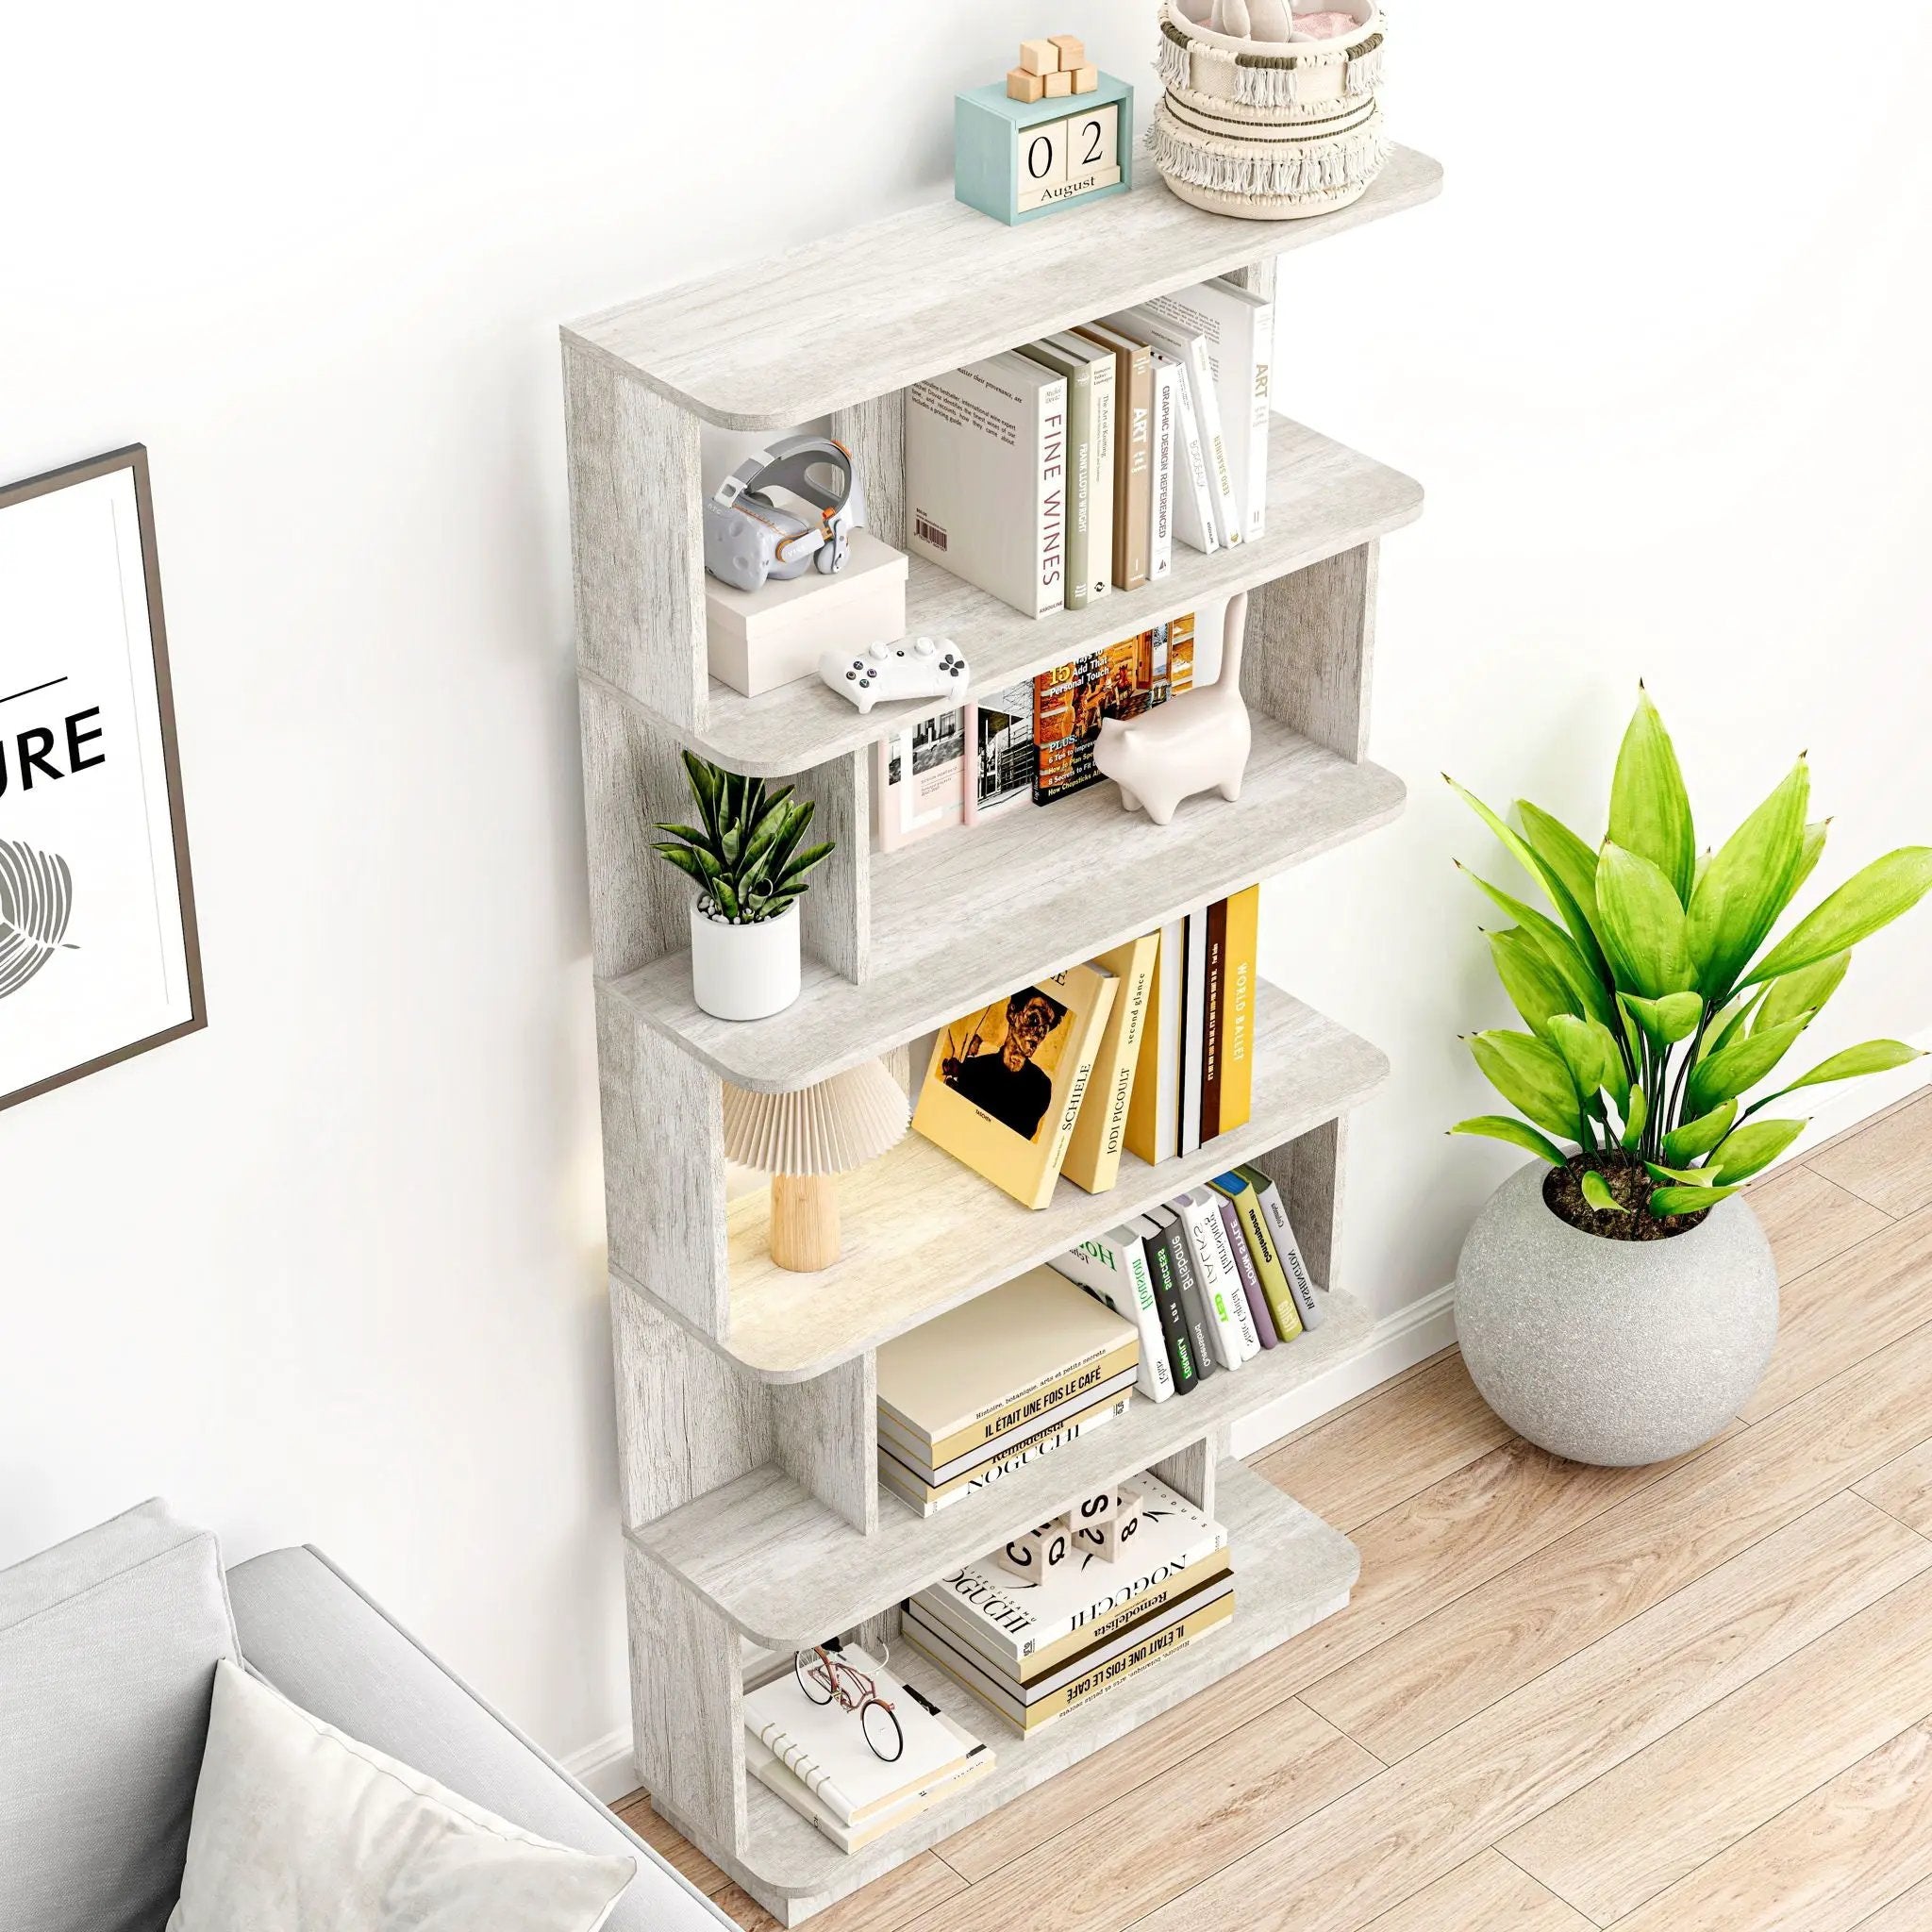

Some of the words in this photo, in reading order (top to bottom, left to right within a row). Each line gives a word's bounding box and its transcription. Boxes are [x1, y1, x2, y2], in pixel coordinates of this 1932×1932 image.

[1041, 176, 1095, 201] August
[1255, 364, 1269, 397] ART
[1103, 421, 1108, 429] of
[1133, 408, 1148, 443] ART
[1044, 414, 1061, 481] FINE
[1079, 442, 1089, 469] FRANK
[1161, 433, 1170, 471] DESIGN
[1078, 470, 1088, 499] LLOYD
[1078, 500, 1088, 533] WRIGHT
[1159, 473, 1168, 539] REFERENCED
[1042, 490, 1060, 586] WINES
[1050, 665, 1071, 686] 15
[1073, 665, 1088, 676] Add
[1091, 657, 1108, 670] That
[1050, 675, 1084, 697] Personal
[1087, 667, 1109, 682] Touch
[0, 706, 106, 798] RE
[1049, 735, 1077, 753] PLUS:
[1055, 752, 1066, 761] Tips
[1048, 765, 1060, 774] How
[1070, 758, 1082, 767] Plan
[1082, 752, 1094, 760] Spe
[1054, 771, 1075, 783] Secrets
[1048, 788, 1060, 796] How
[1061, 774, 1091, 790] Chopsticks
[1235, 962, 1248, 1011] WORLD
[1127, 1009, 1139, 1044] second
[1134, 973, 1145, 1006] glance
[1233, 1015, 1245, 1061] BALLET
[1062, 1063, 1091, 1131] SCHIELE
[1112, 1068, 1130, 1124] PICOULT
[974, 1108, 991, 1123] TASCHEN
[1107, 1124, 1121, 1155] JODI
[1040, 1374, 1054, 1387] arts
[1055, 1371, 1061, 1379] et
[1062, 1361, 1081, 1375] petits
[1082, 1349, 1107, 1364] secrets
[985, 1424, 994, 1438] IL
[995, 1408, 1022, 1433] ÉTAIT
[1024, 1398, 1041, 1417] UNE
[1043, 1387, 1063, 1407] FOIS
[1065, 1380, 1076, 1396] LE
[1078, 1365, 1102, 1390] CAFÉ
[967, 1424, 1080, 1494] NOGUCHI
[1081, 1494, 1108, 1518] S
[1121, 1517, 1138, 1542] 8
[1049, 1536, 1065, 1566] Q
[1071, 1554, 1187, 1632] NOGUCHI
[1093, 1591, 1168, 1637] Remodelista
[1149, 1631, 1174, 1655] ÉTAIT
[1177, 1624, 1184, 1639] IL
[1106, 1658, 1126, 1679] FOIS
[1128, 1645, 1146, 1667] UNE
[1067, 1681, 1091, 1704] CAFÉ
[1092, 1671, 1104, 1686] LE
[1113, 1677, 1127, 1688] arts
